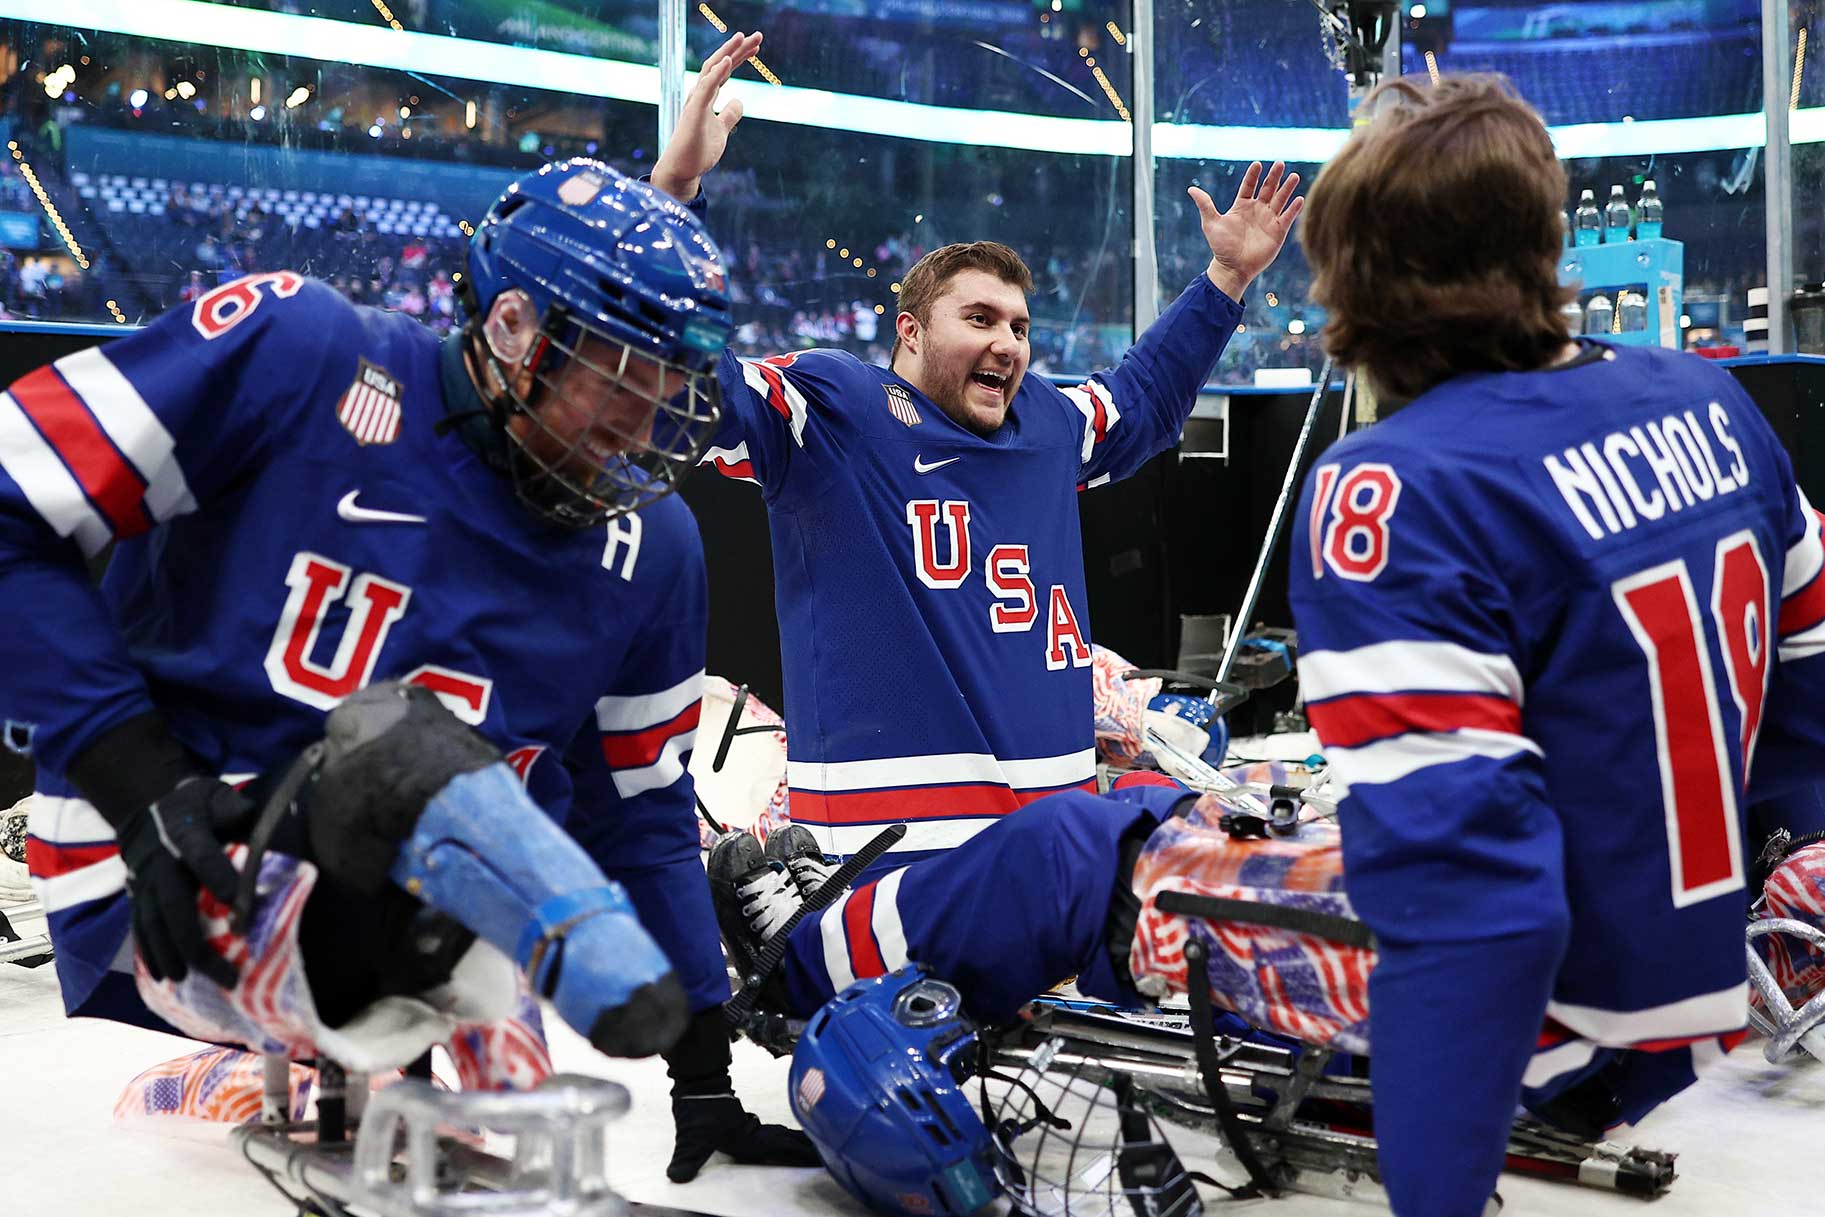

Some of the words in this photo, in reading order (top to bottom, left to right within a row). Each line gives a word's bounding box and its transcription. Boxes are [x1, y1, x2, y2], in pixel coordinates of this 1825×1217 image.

[191, 269, 305, 340] 6
[363, 367, 397, 398] USA
[888, 387, 909, 401] USA
[1542, 401, 1750, 540] NICHOLS
[601, 505, 643, 582] A
[1308, 461, 1402, 583] 18
[905, 499, 1094, 671] USA
